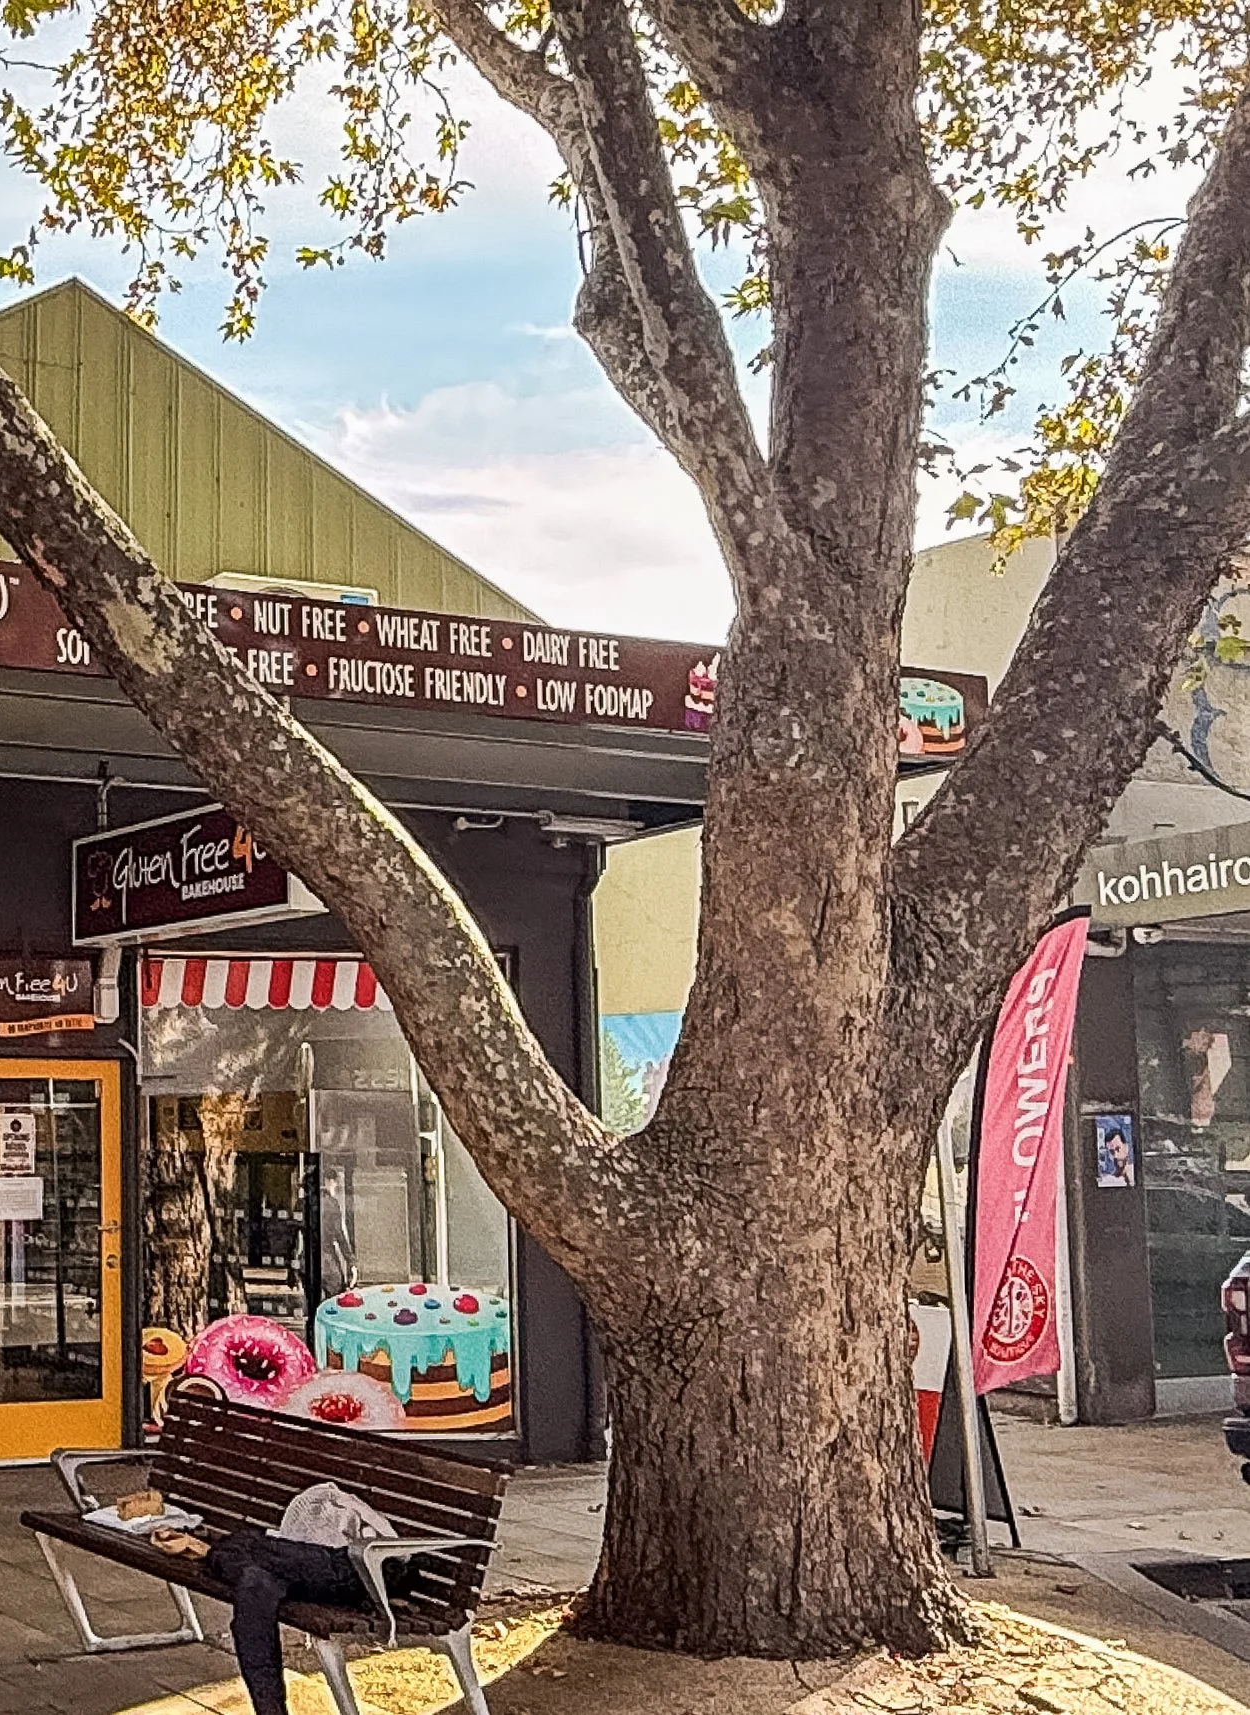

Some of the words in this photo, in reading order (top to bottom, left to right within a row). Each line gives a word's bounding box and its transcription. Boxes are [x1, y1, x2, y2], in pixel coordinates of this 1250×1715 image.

[253, 600, 293, 636] NUT
[301, 606, 347, 643] FREE
[376, 613, 442, 653] WHEAT
[449, 621, 492, 658] FREE
[522, 631, 571, 665] DAIRY
[578, 637, 620, 672] FREE
[247, 649, 295, 686] FREE
[328, 658, 415, 698] FRUCTOSE
[424, 666, 507, 707] FRIENDLY
[536, 677, 577, 711] LOW
[584, 682, 654, 720] FODMAP
[112, 846, 181, 925] Gluten
[182, 872, 246, 901] BAKEHOUSE
